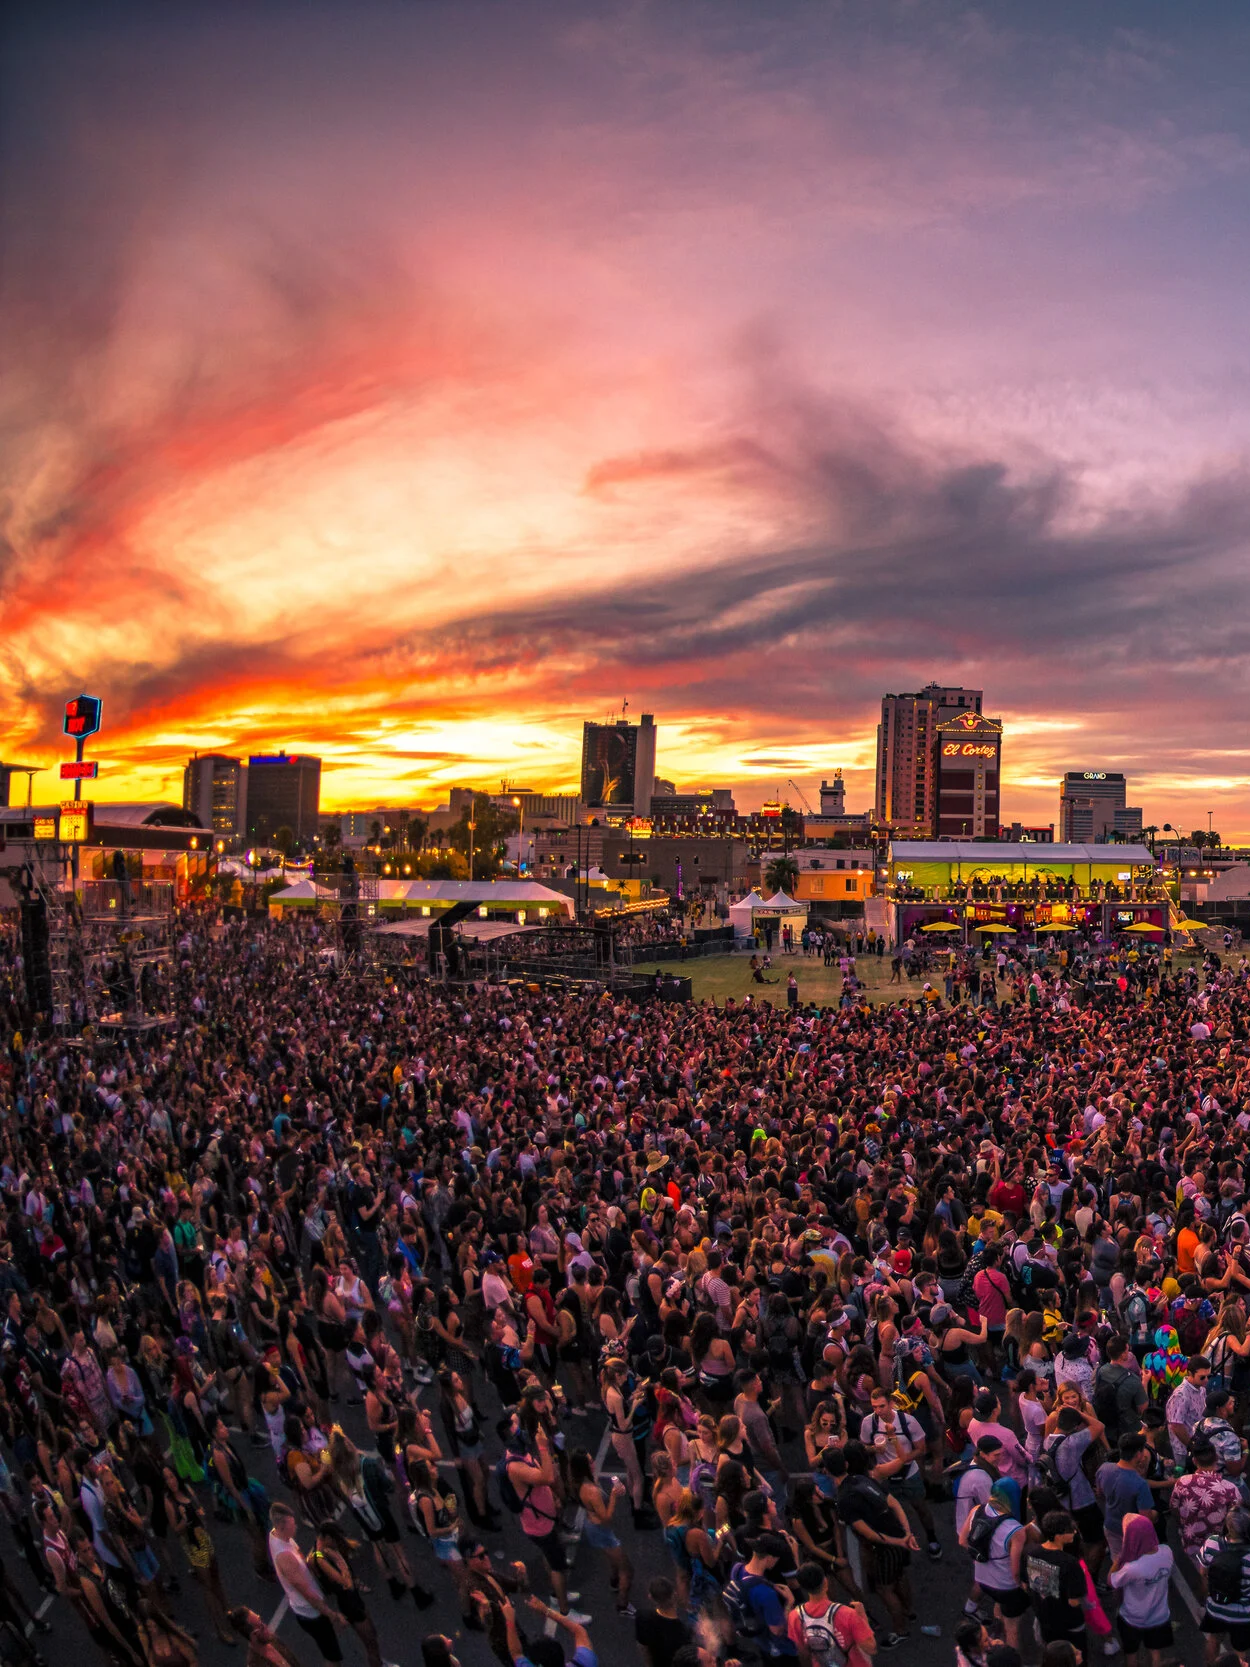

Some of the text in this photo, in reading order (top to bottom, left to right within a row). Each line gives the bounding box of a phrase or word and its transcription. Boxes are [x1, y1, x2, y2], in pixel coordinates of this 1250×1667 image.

[943, 743, 996, 759] El Cortez
[1083, 772, 1107, 780] GRAND
